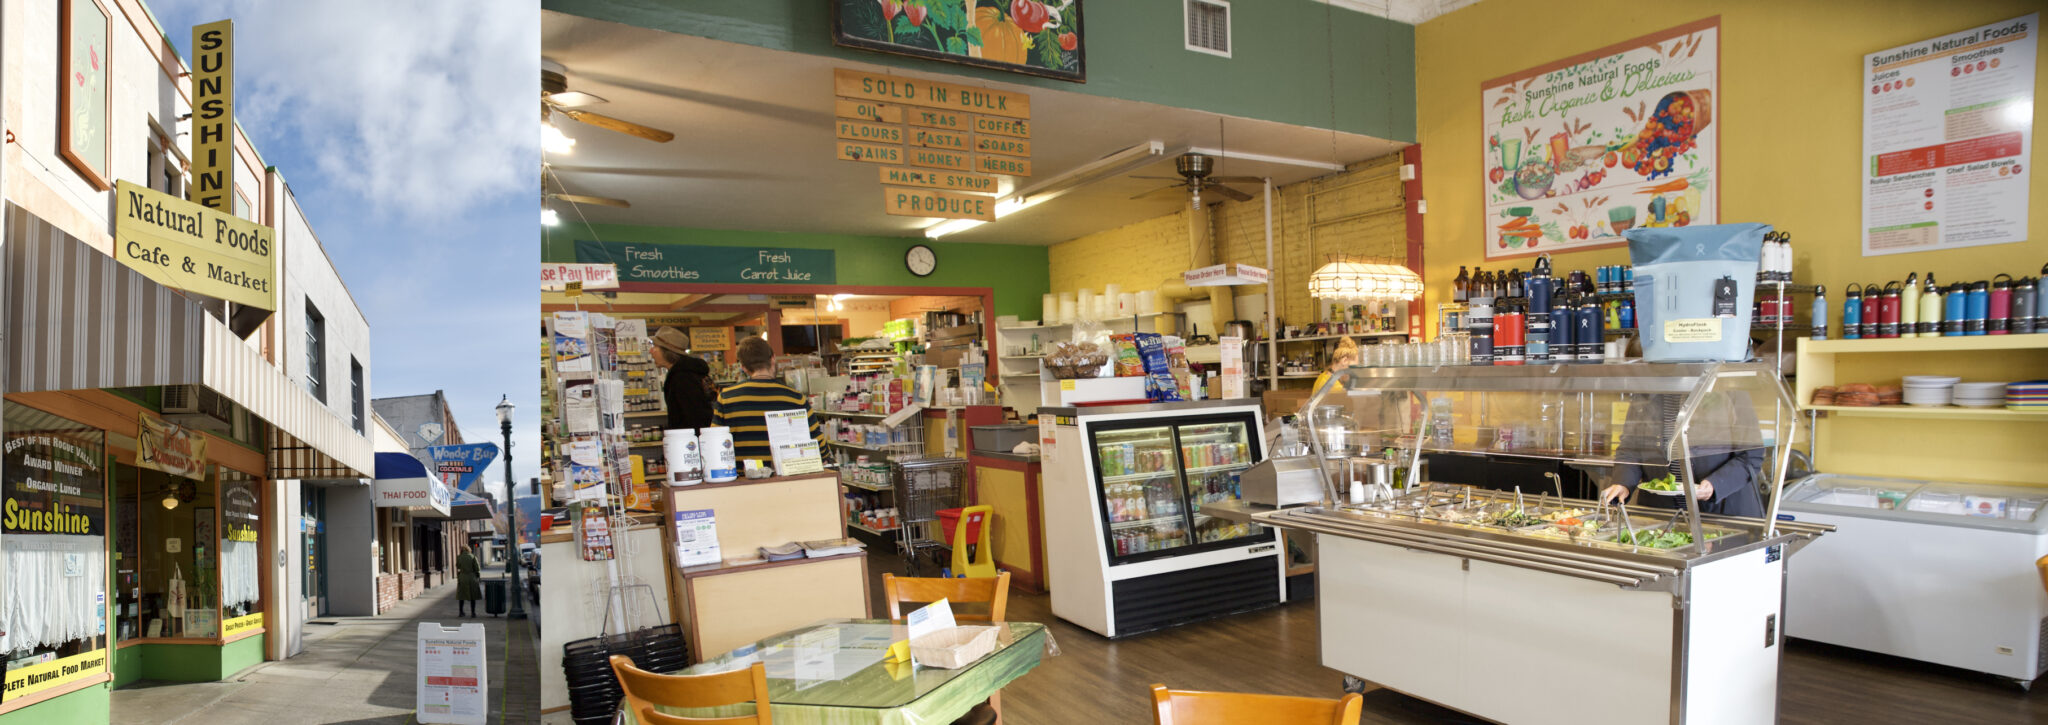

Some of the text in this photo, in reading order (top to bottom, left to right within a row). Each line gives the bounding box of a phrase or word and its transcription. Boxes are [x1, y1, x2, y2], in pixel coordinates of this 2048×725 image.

[1872, 22, 2028, 67] Sunshine Natural Foods
[1952, 46, 2004, 64] Smoothies
[1525, 58, 1660, 101] Sunshine Natural Foods
[1872, 70, 1900, 82] Juices
[864, 78, 1007, 110] SOLD IN BULK
[1540, 91, 1598, 118] Organic
[1600, 83, 1618, 102] &
[1620, 70, 1696, 98] Delicious
[200, 30, 224, 209] SUNSHINE
[858, 105, 880, 118] OIL
[921, 112, 956, 126] TEAS
[841, 124, 899, 140] FLOURS
[978, 120, 1026, 134] COFFEE
[917, 132, 962, 147] PASTA
[983, 139, 1024, 153] SOAPS
[846, 146, 898, 160] GRAINS
[918, 152, 962, 167] HONEY
[984, 158, 1024, 173] HERBS
[889, 170, 990, 188] MAPLE SYRUP
[897, 194, 984, 215] PRODUCE
[128, 190, 268, 256] Natural Foods
[625, 246, 663, 262] Fresh
[758, 250, 792, 264] Fresh
[127, 241, 268, 293] Cafe & Market
[558, 266, 582, 281] Pay
[585, 266, 612, 280] Here
[630, 264, 700, 280] Smoothies
[740, 268, 812, 281] Carrot Juice
[566, 281, 582, 290] FREE
[5, 436, 96, 471] BEST OF THE ROGUE VALLEY
[434, 446, 470, 460] Wonder
[24, 454, 82, 476] AWARD WINNER
[26, 477, 58, 492] ORGANIC
[60, 482, 80, 496] LUNCH
[382, 490, 426, 499] THAI FOOD
[4, 497, 90, 534] Sunshine
[228, 523, 258, 542] Sunshine
[28, 670, 59, 686] NATURAL
[62, 665, 78, 676] FOOD
[80, 658, 104, 670] MARKET
